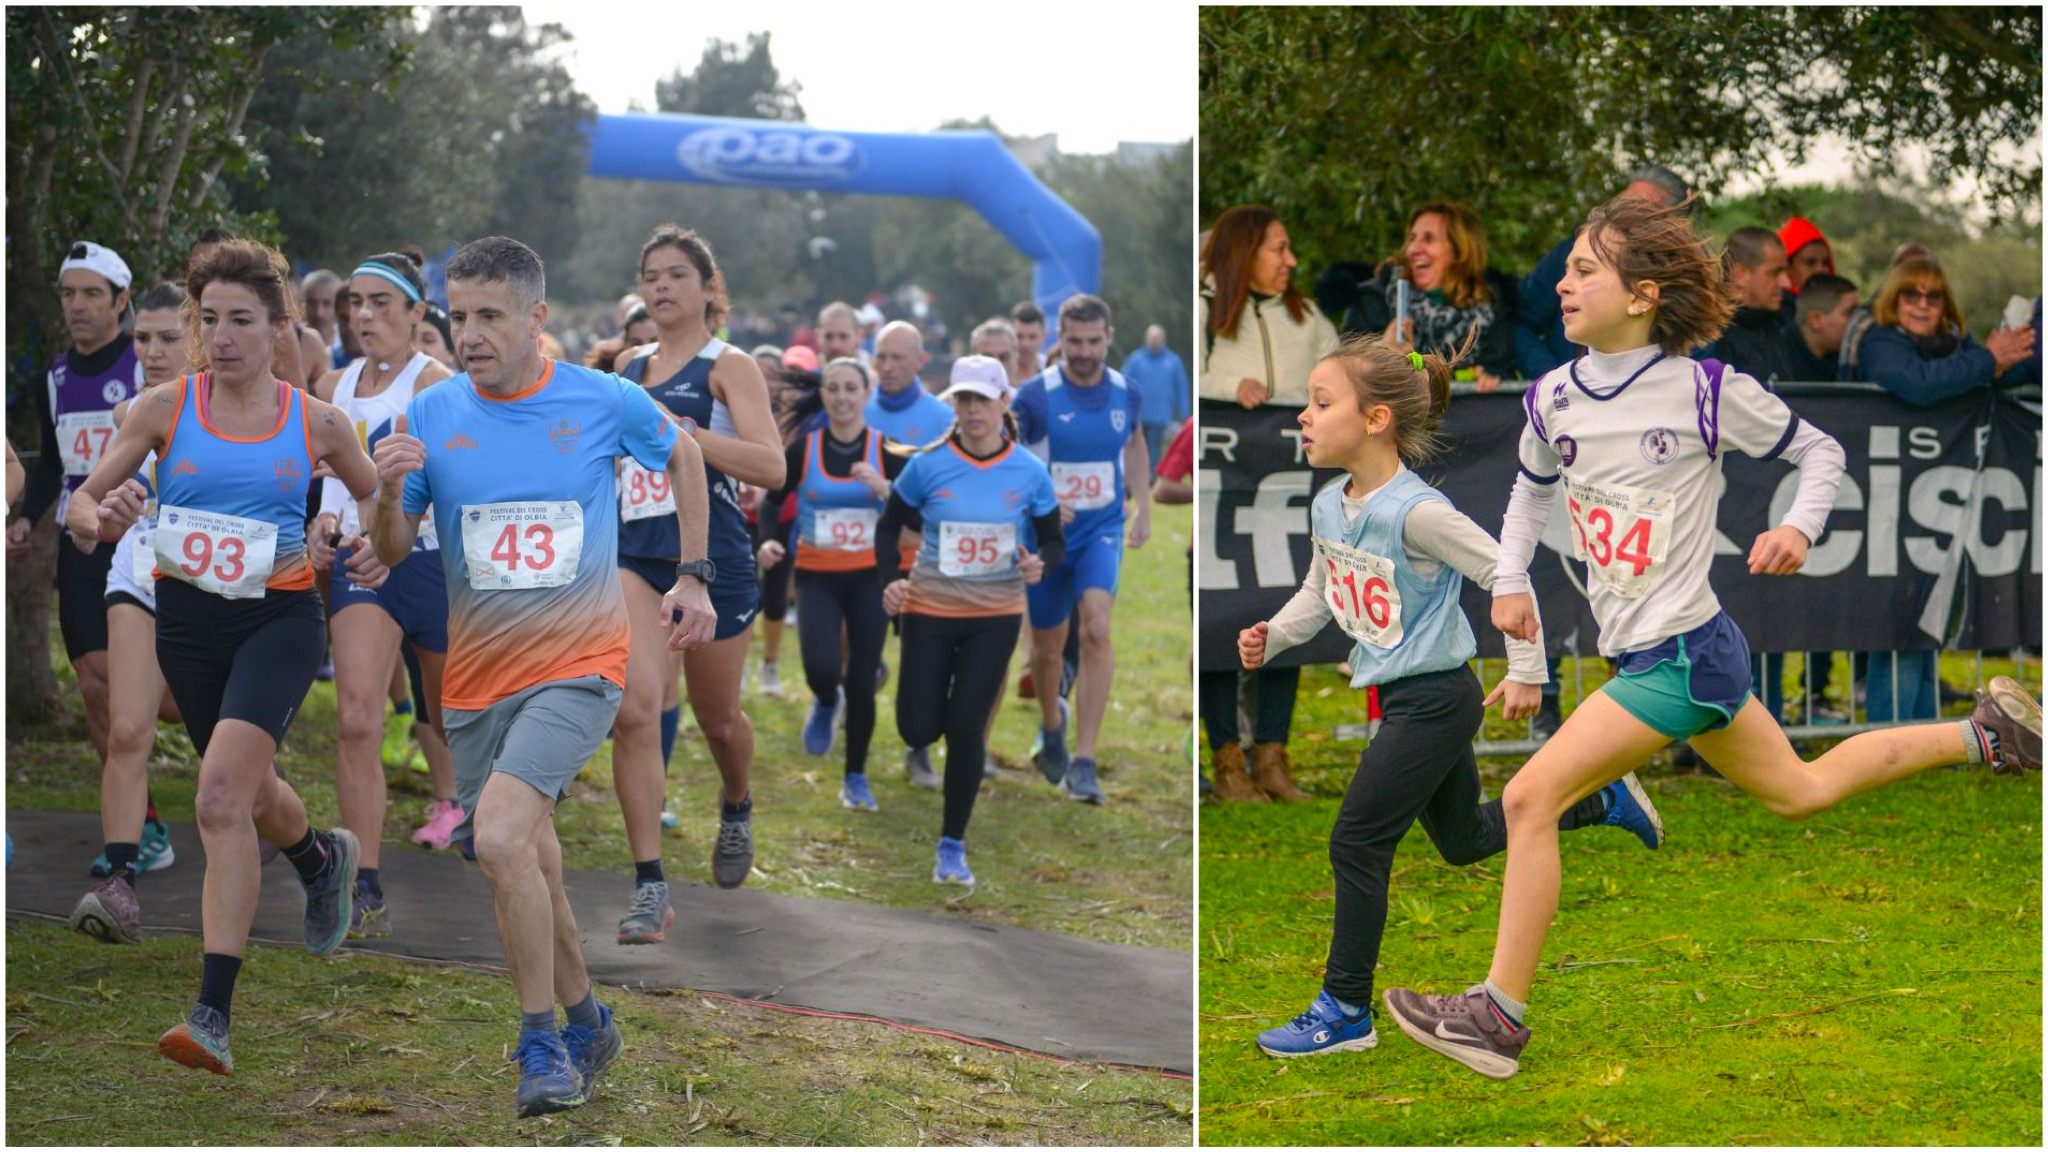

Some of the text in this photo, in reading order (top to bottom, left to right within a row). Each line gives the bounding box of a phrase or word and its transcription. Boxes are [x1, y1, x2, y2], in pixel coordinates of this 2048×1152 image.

[702, 127, 856, 175] pao
[73, 428, 114, 461] 47
[629, 468, 671, 505] 89
[1058, 474, 1101, 500] 29
[490, 523, 556, 571] 43
[832, 521, 868, 546] 92
[957, 536, 998, 564] 95
[1568, 494, 1653, 577] 534
[181, 531, 246, 582] 93
